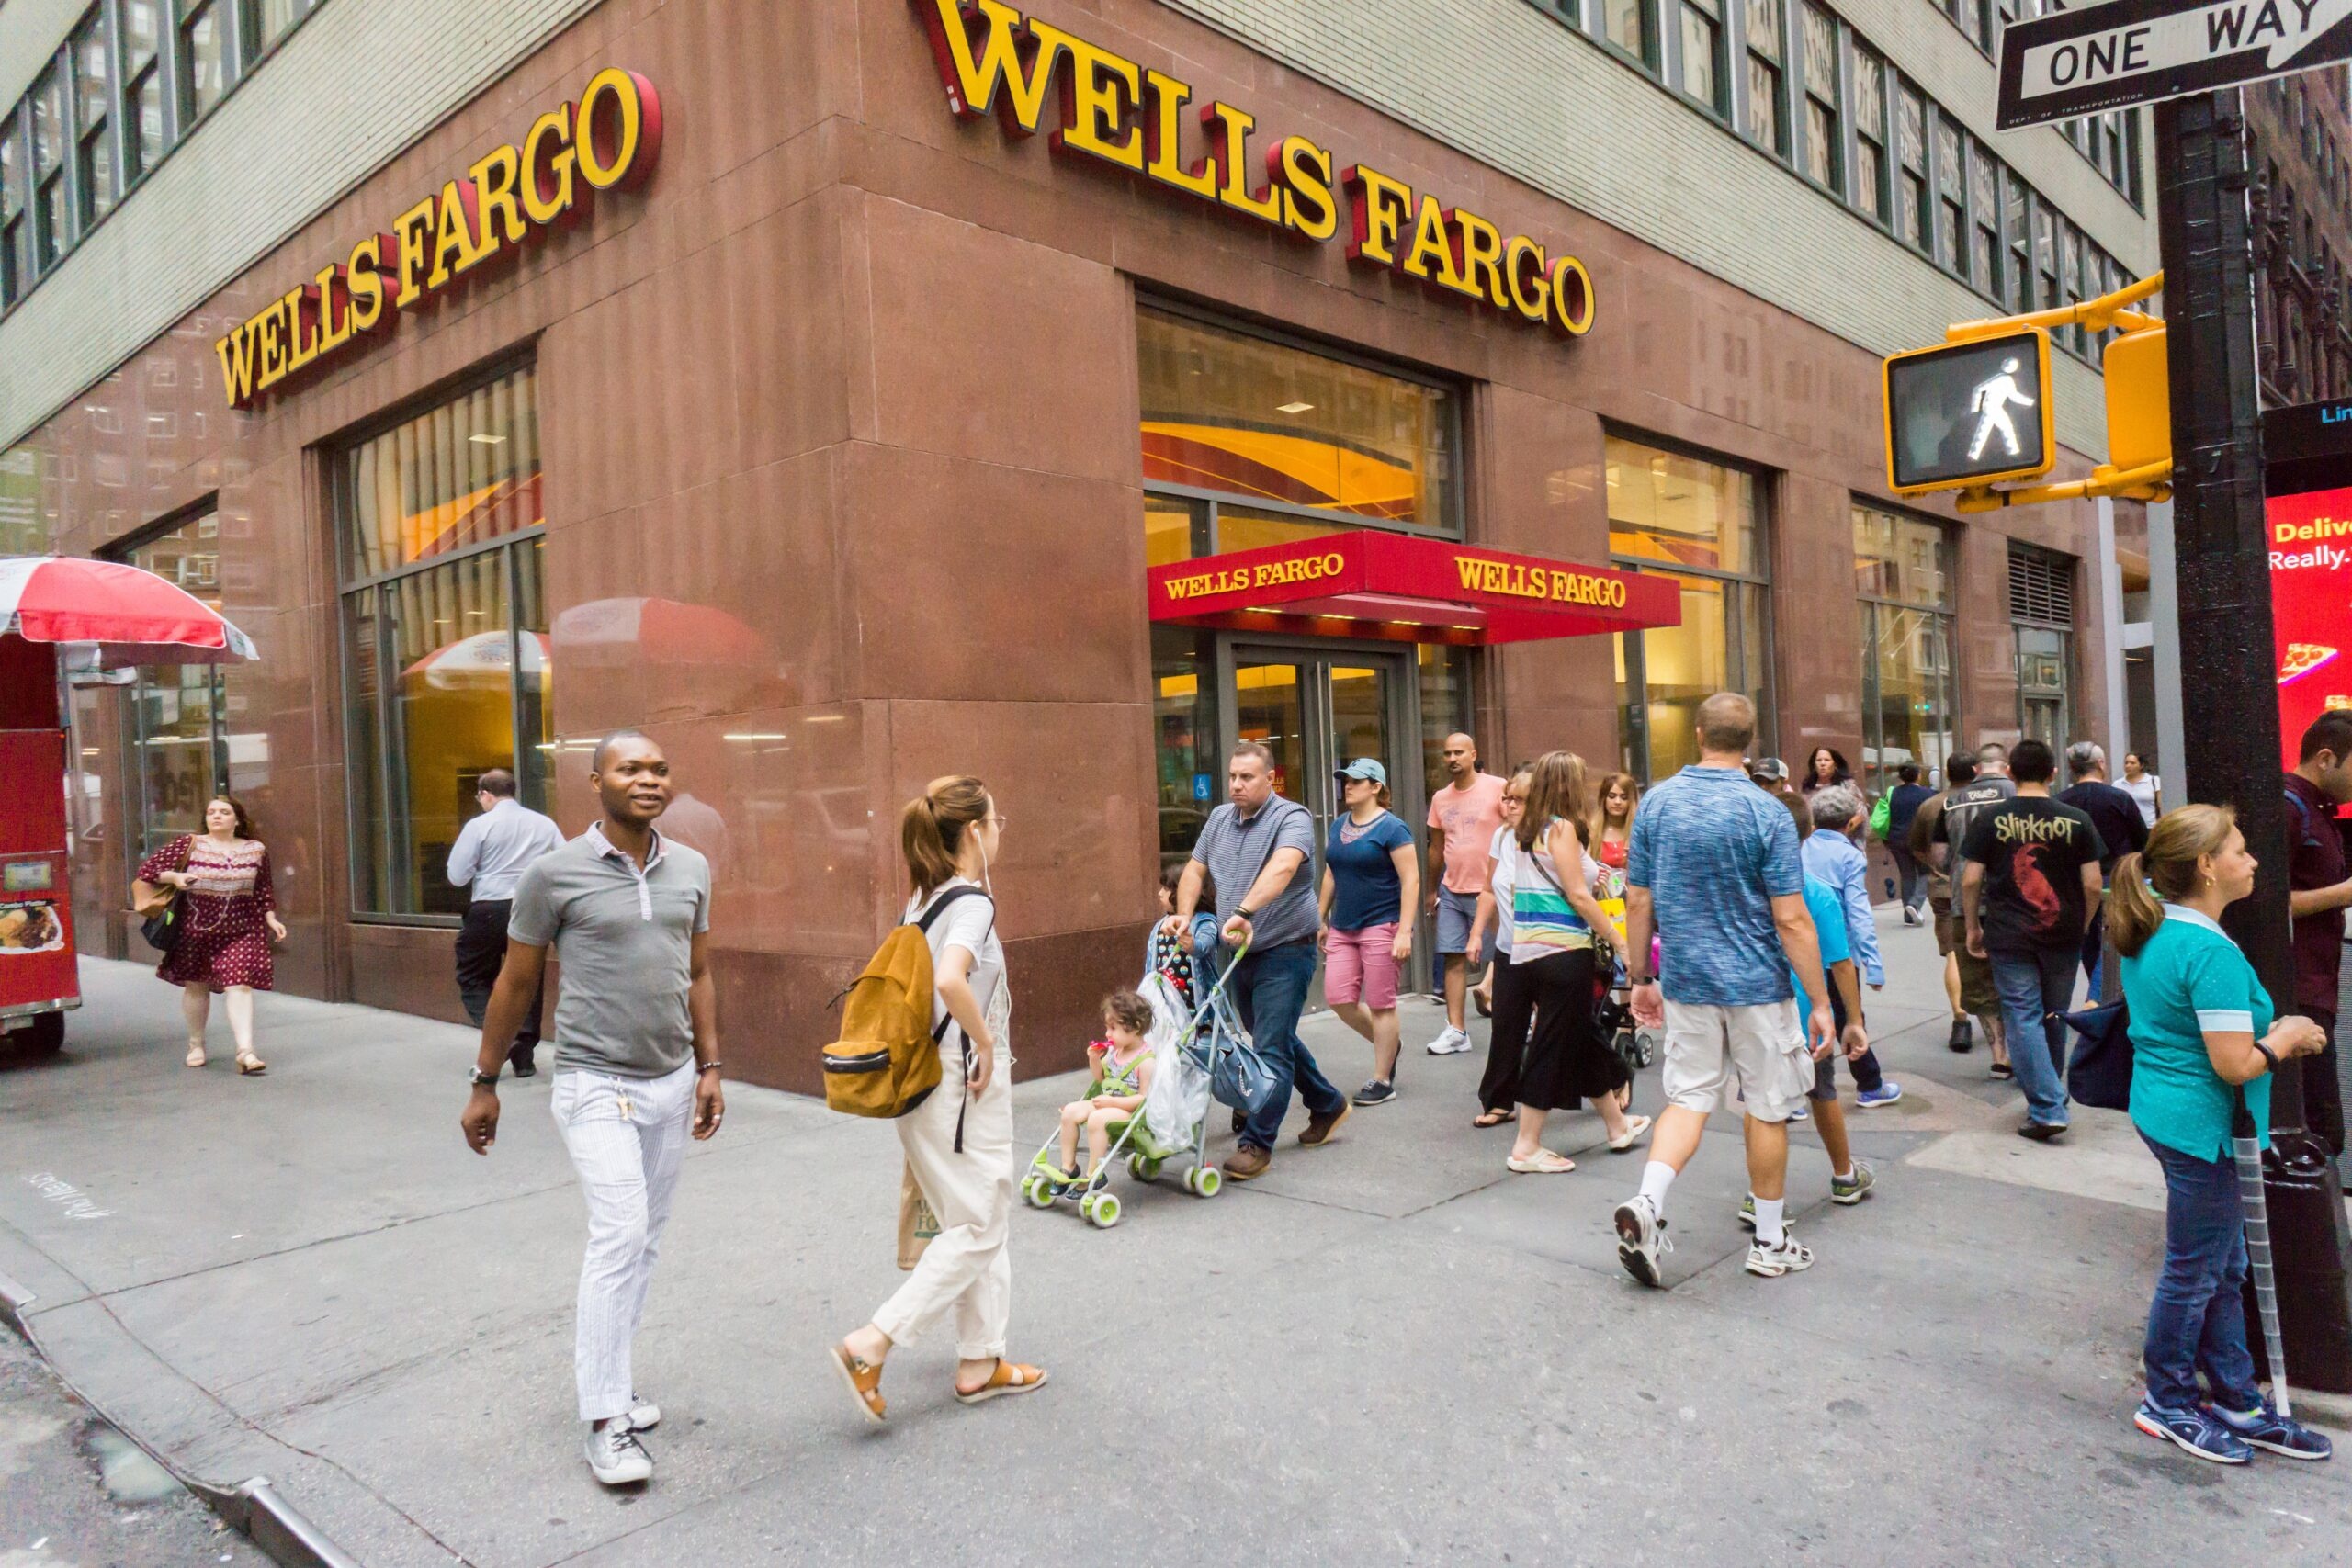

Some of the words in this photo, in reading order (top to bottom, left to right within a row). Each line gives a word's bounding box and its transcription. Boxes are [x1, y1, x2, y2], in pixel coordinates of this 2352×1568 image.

[2050, 27, 2151, 86] ONE
[2207, 0, 2319, 53] WAY
[2062, 93, 2143, 114] TRANSPORTATION
[932, 0, 1340, 243] WELLS
[1354, 164, 1597, 338] FARGO
[216, 233, 384, 407] WELLS
[393, 66, 641, 309] FARGO
[2275, 517, 2352, 543] Deliv
[1165, 569, 1250, 600] WELLS
[1253, 553, 1344, 587] FARGO
[2268, 544, 2351, 570] Really.
[1454, 556, 1547, 598] WELLS
[1550, 570, 1626, 609] FARGO
